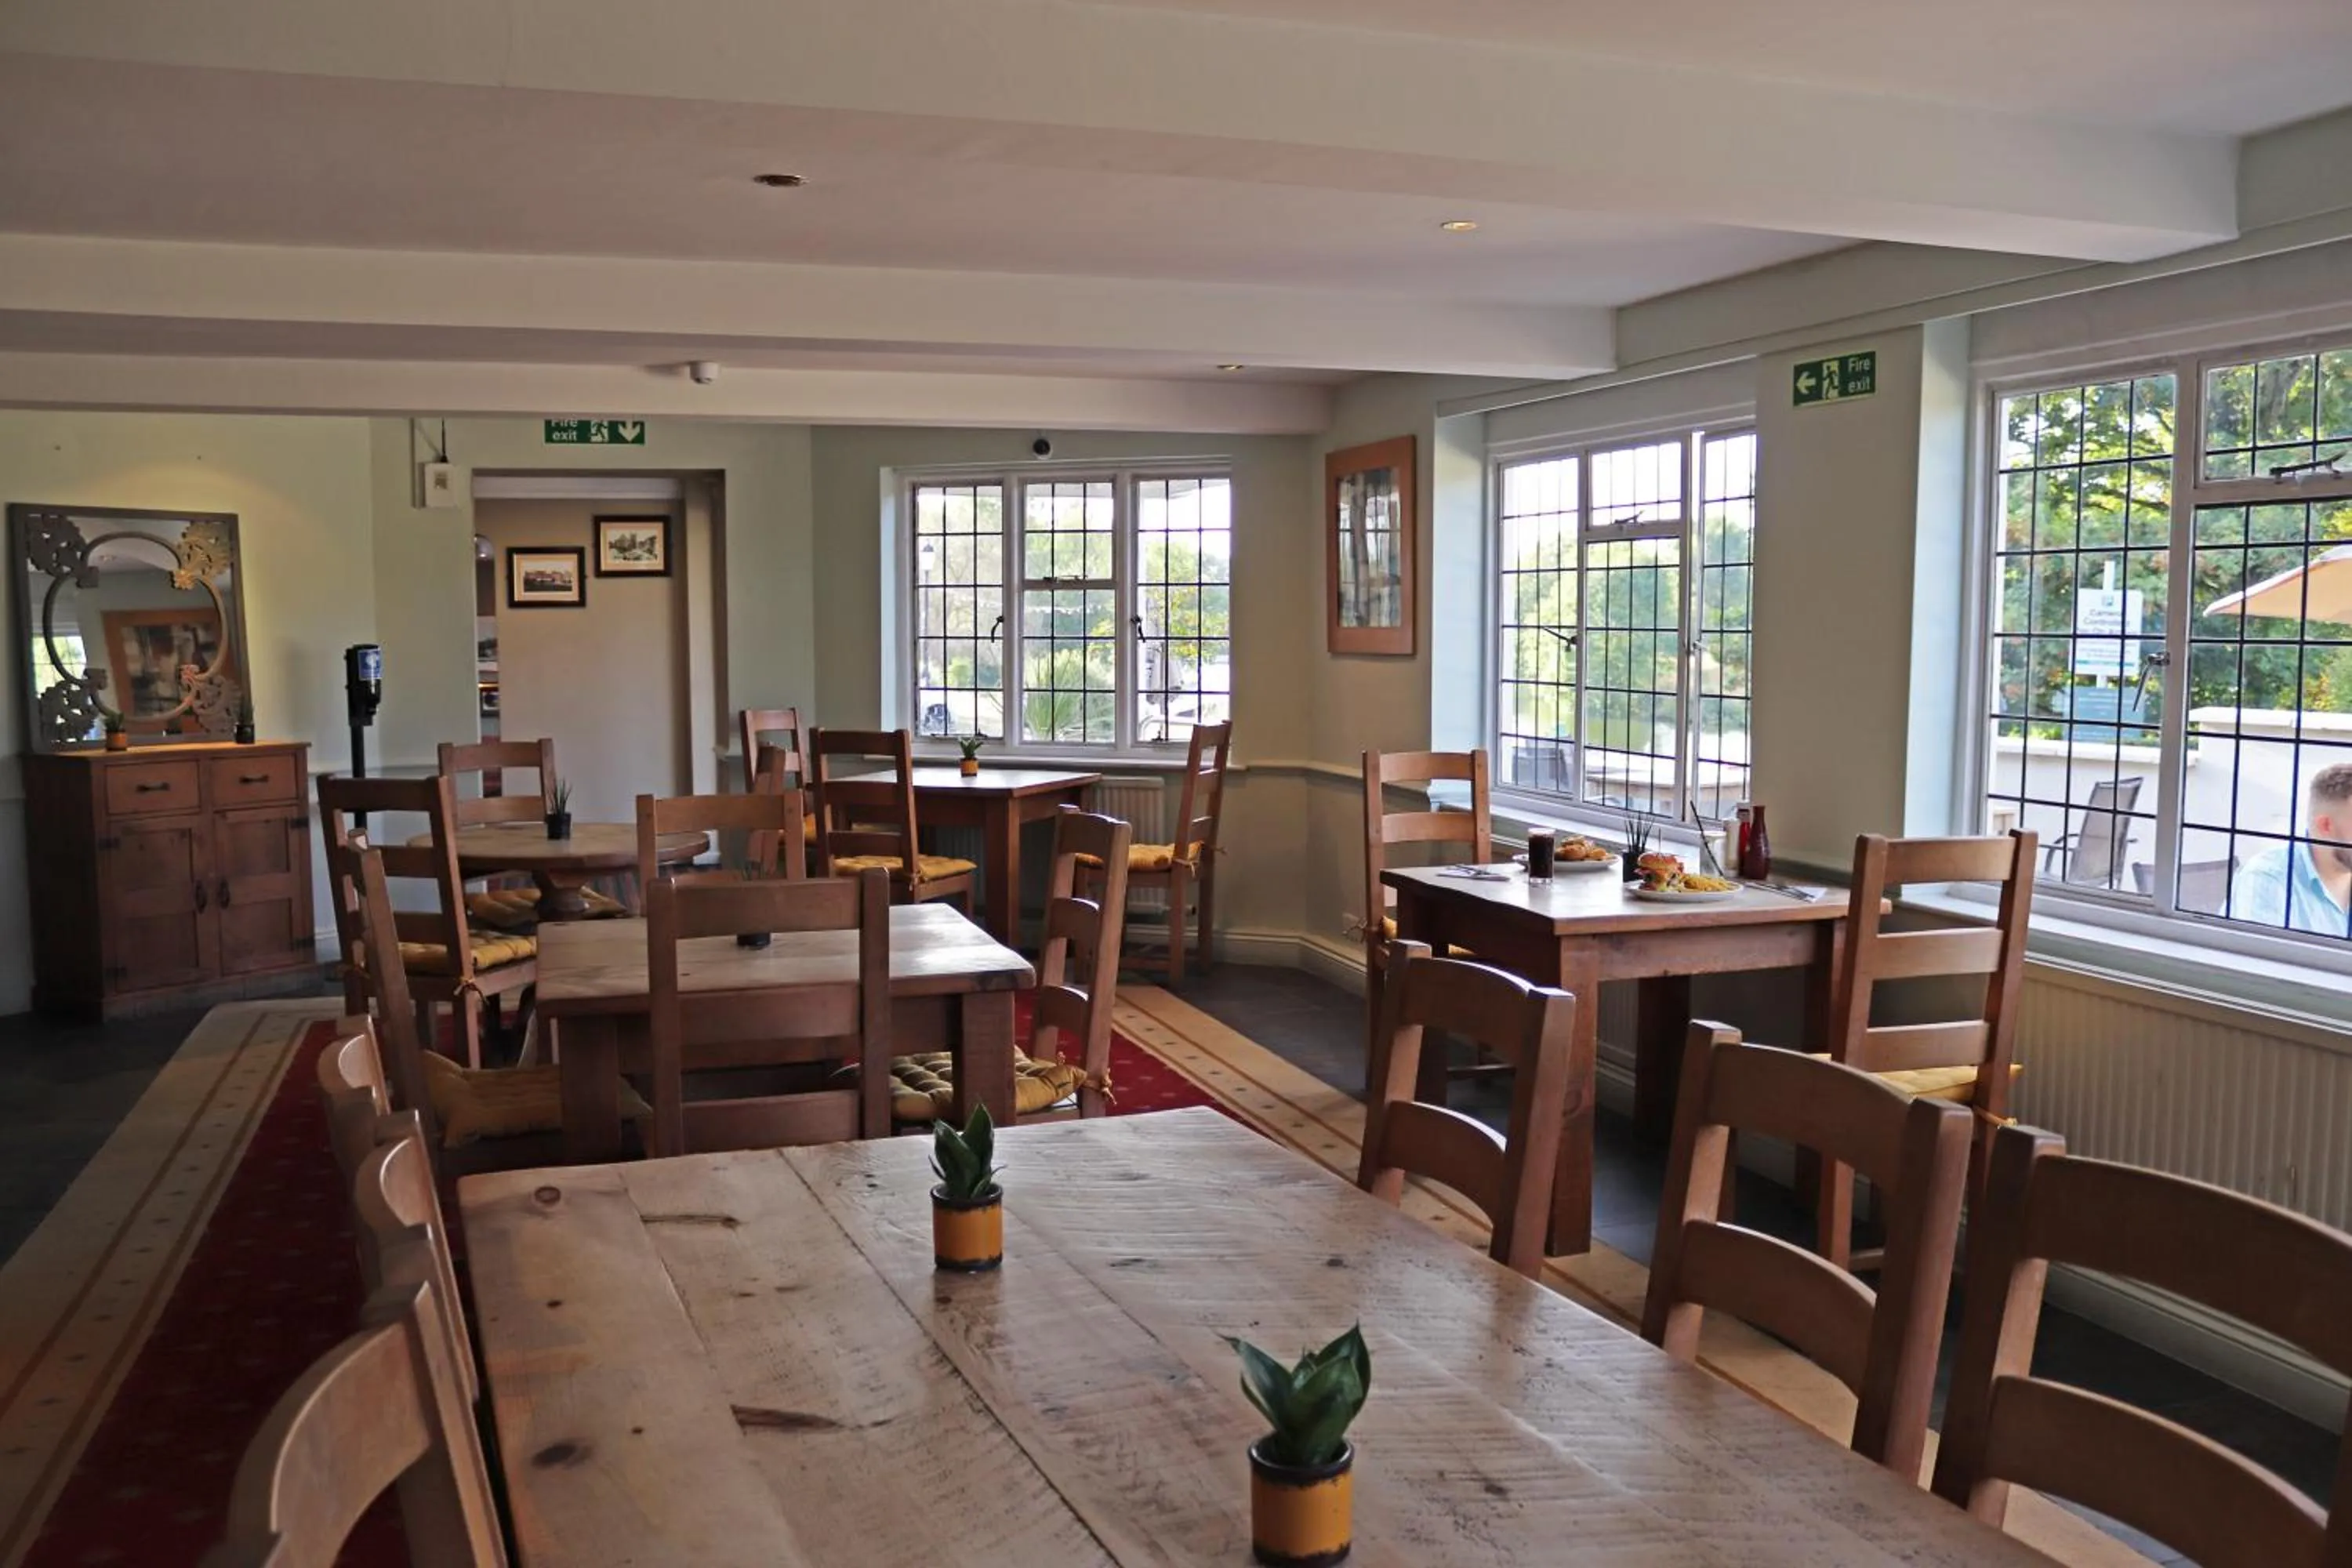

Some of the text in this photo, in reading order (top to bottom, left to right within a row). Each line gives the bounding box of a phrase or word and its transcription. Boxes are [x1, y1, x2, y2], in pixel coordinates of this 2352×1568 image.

[1848, 357, 1871, 372] Fire
[1849, 376, 1871, 393] exit
[552, 430, 577, 441] exit
